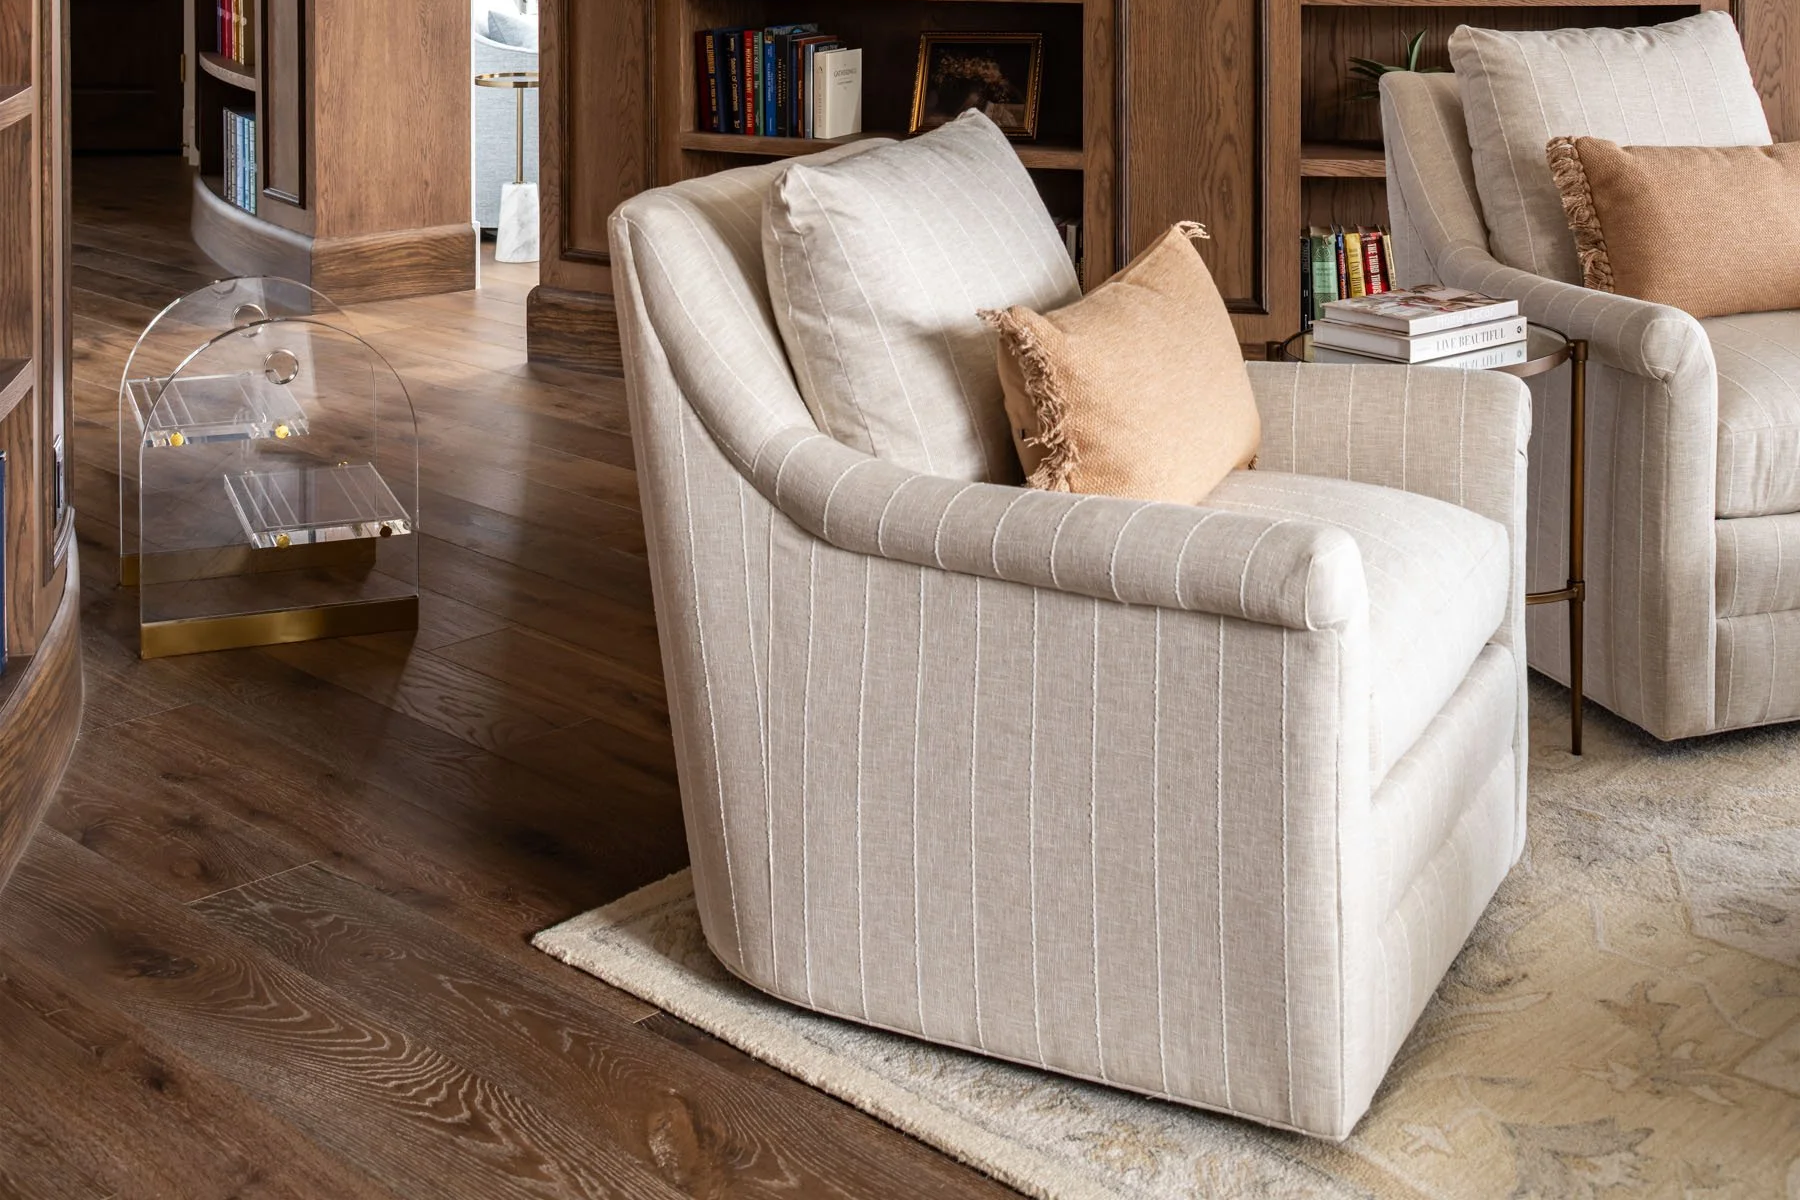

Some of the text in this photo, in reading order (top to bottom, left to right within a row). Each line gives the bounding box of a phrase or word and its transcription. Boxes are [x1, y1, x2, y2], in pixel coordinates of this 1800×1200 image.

[1368, 243, 1378, 254] THE
[1369, 255, 1380, 274] THIRD
[1436, 327, 1506, 352] LIVE BEAUTIFUL
